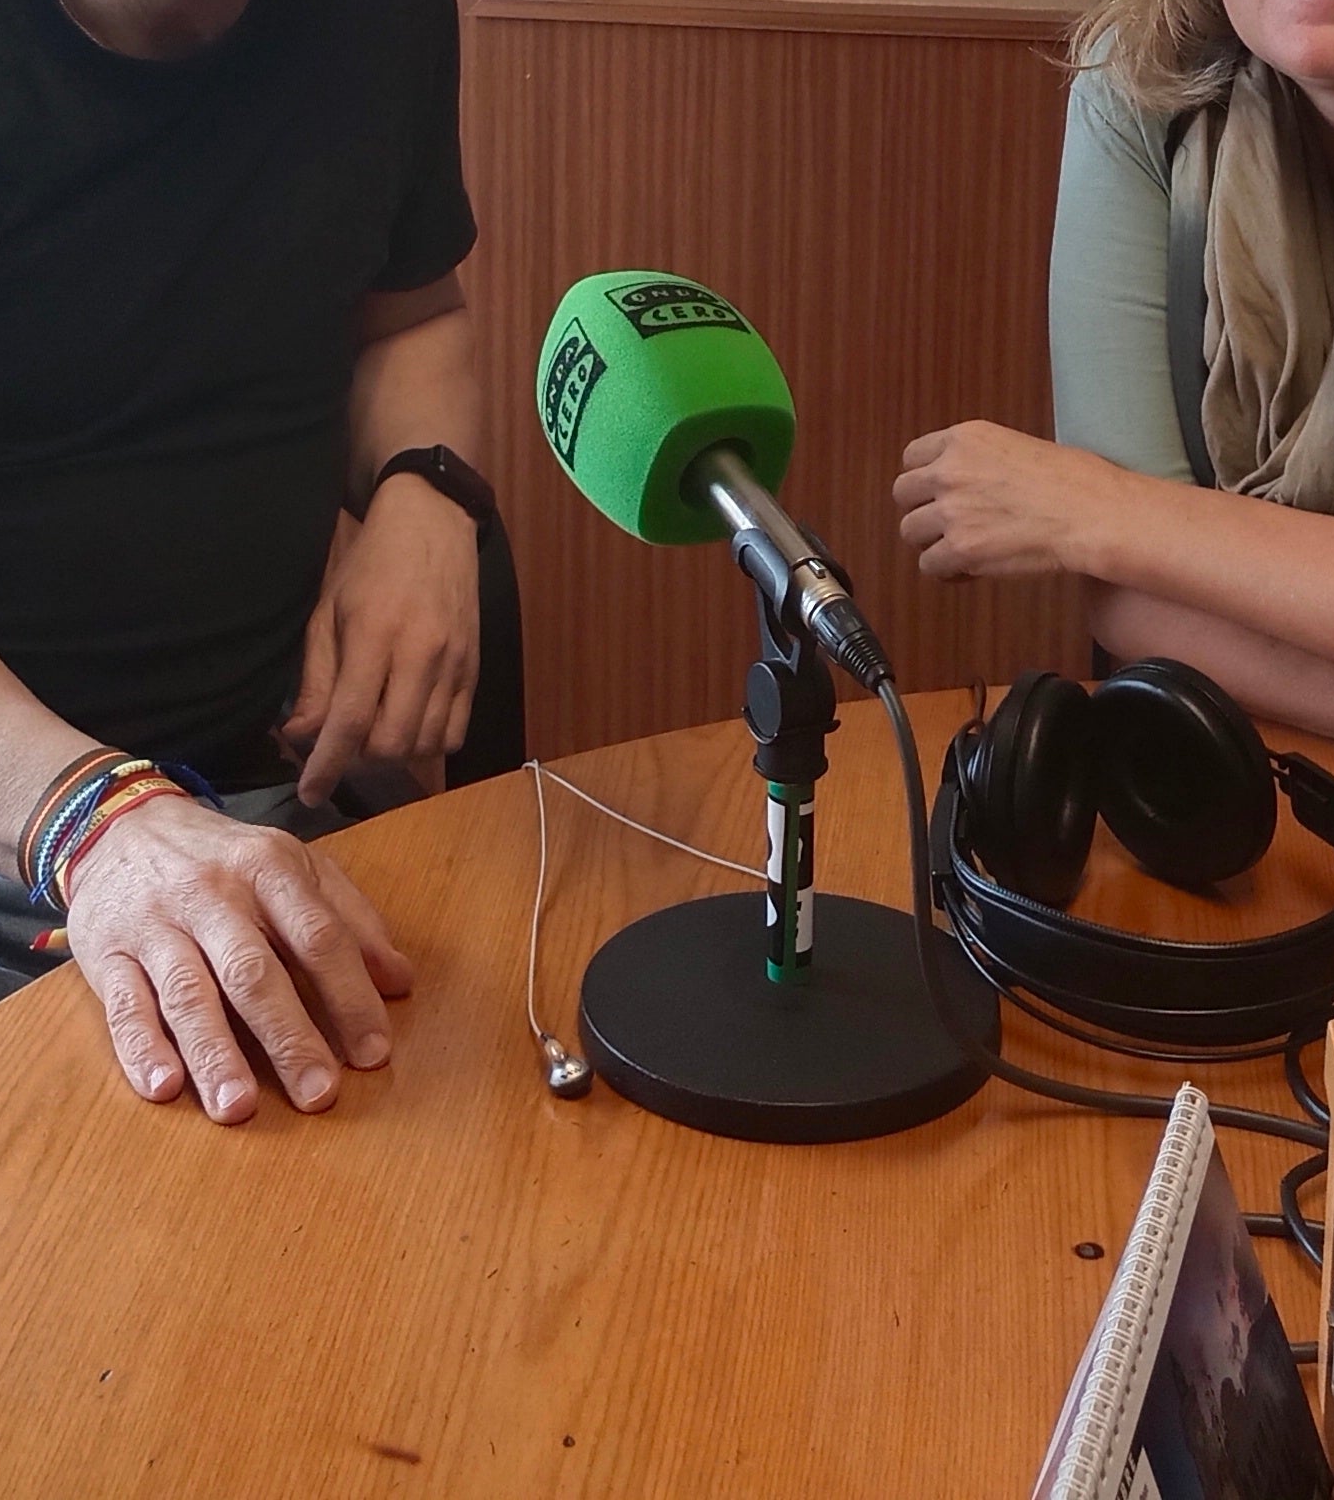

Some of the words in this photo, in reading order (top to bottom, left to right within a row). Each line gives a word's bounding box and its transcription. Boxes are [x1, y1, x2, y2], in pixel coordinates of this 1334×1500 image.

[652, 305, 726, 321] CERO
[546, 346, 575, 423] ONDA
[558, 364, 587, 440] CERO
